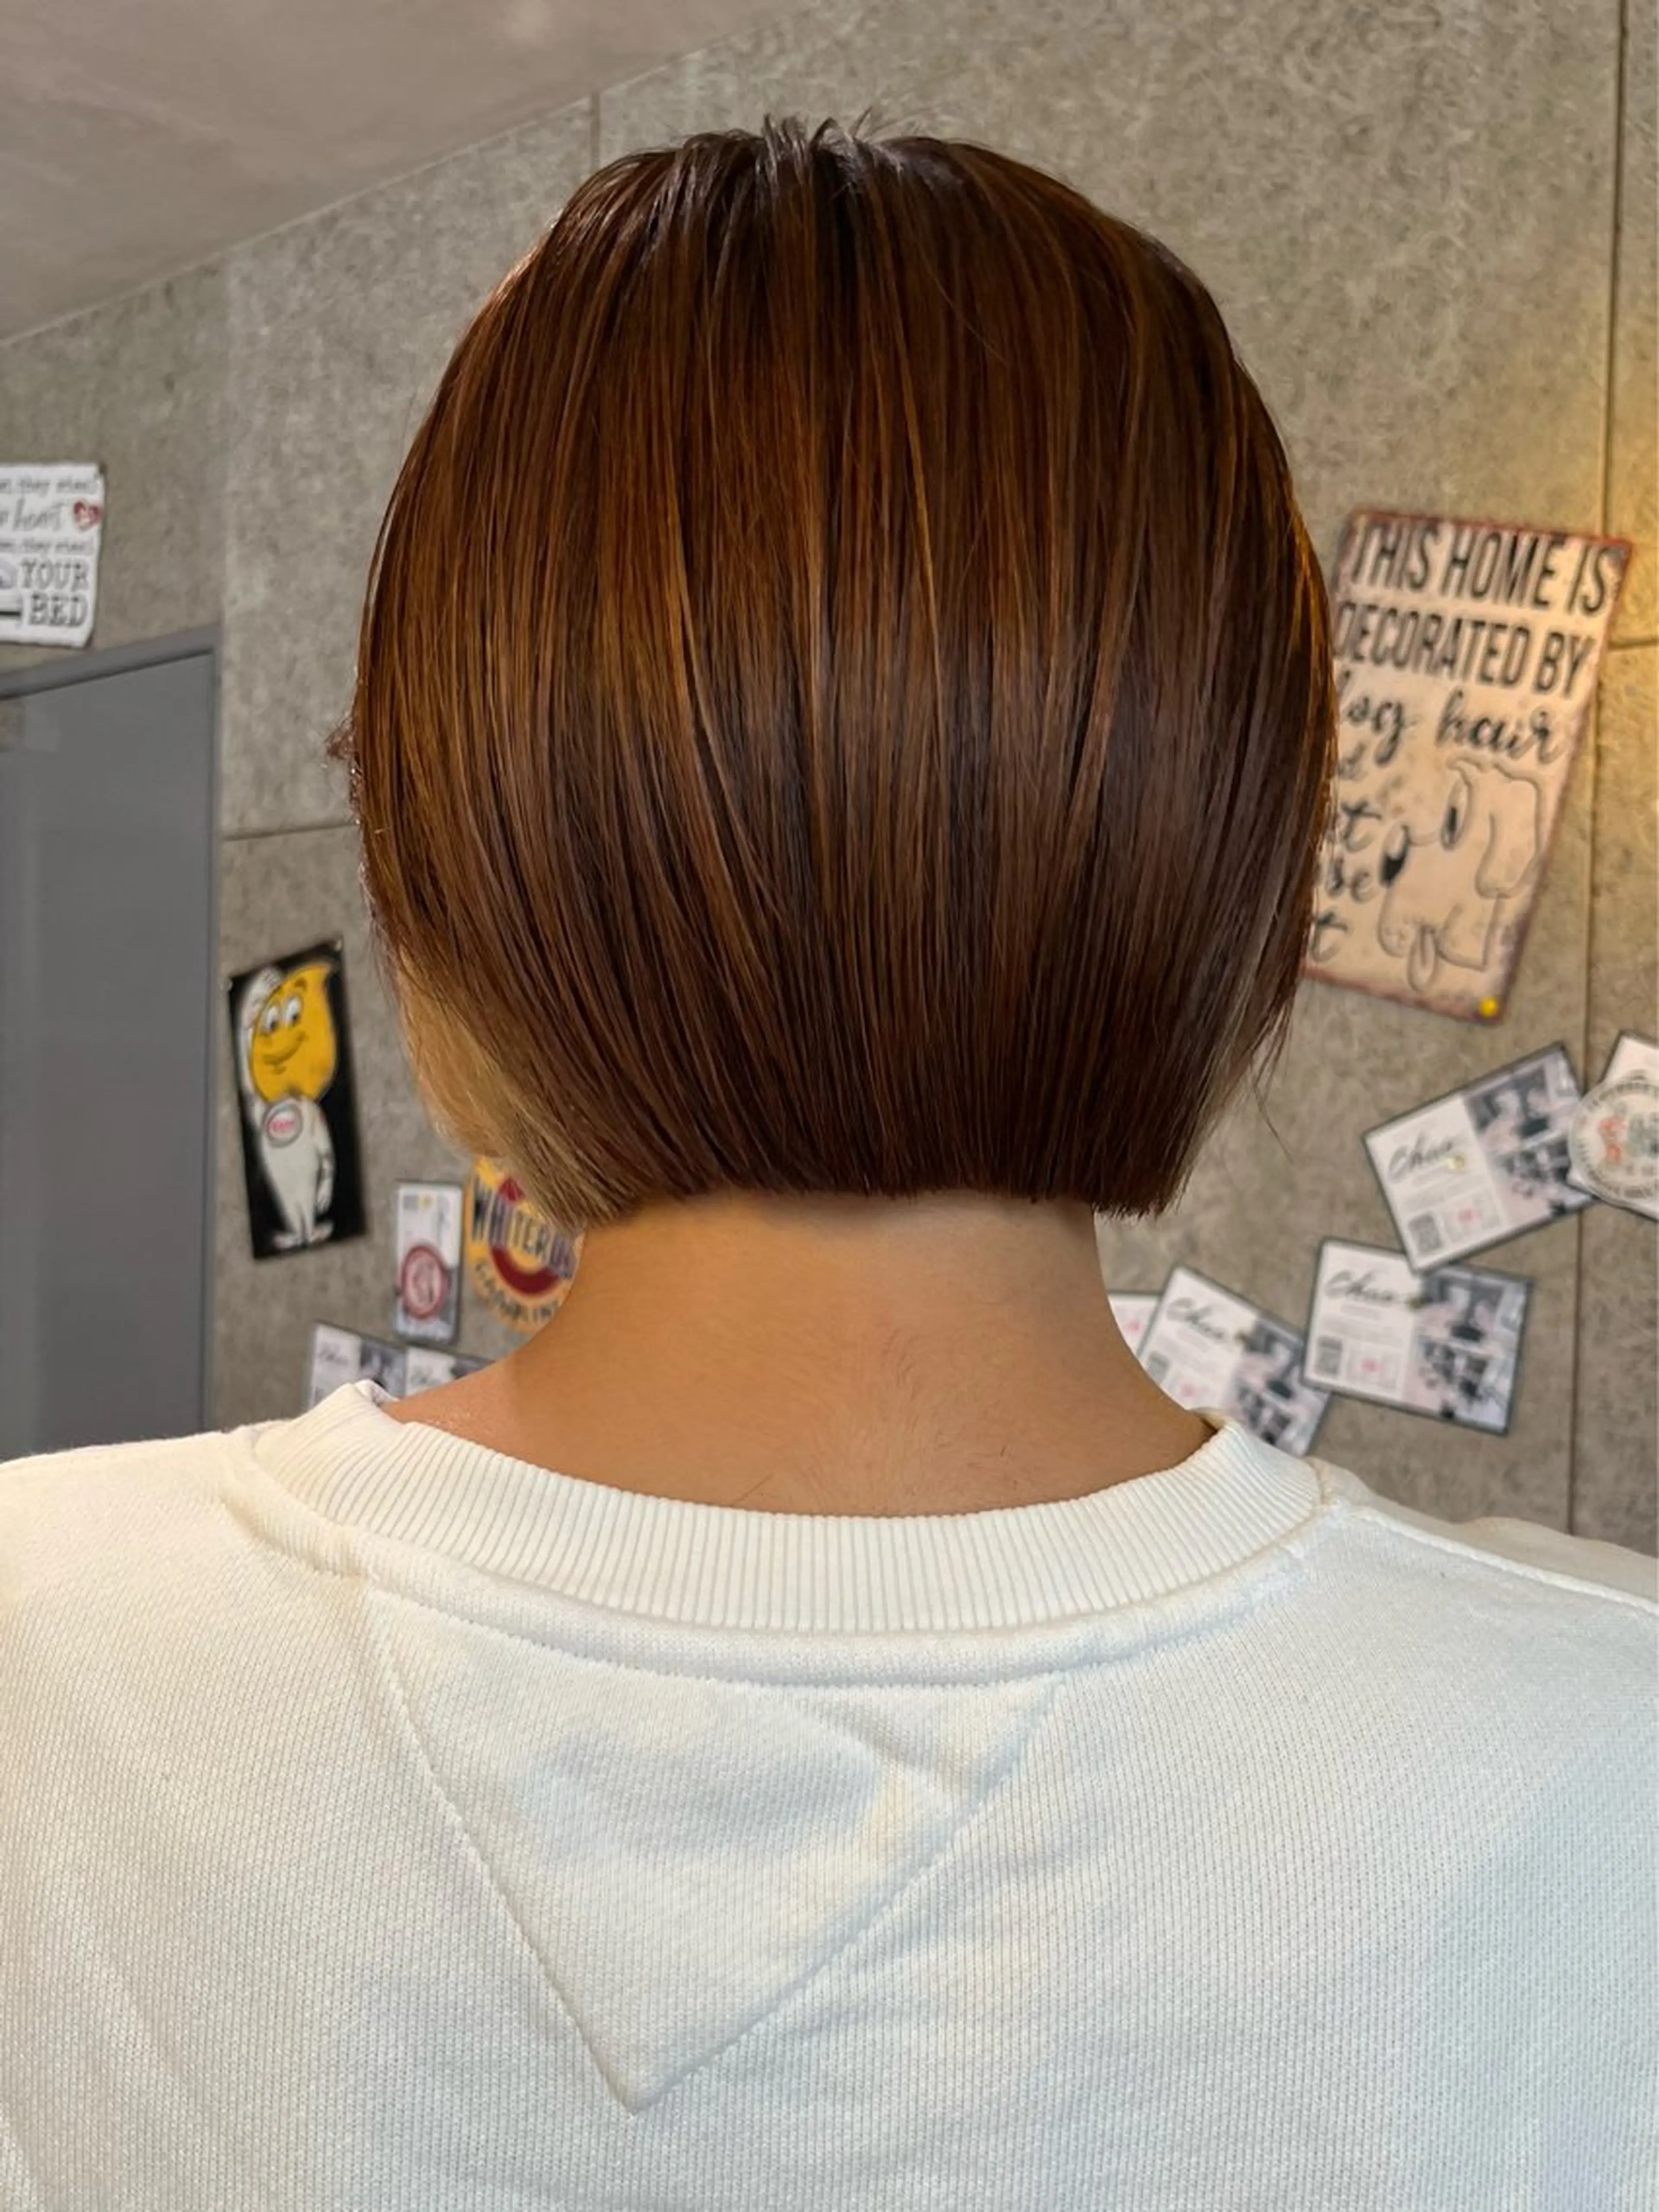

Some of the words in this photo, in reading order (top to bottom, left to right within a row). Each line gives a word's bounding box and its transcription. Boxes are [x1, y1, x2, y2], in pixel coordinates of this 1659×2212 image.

[21, 558, 89, 591] YOUR
[1351, 518, 1439, 589] THIS
[1442, 524, 1565, 607] HOME
[1567, 543, 1614, 618] IS
[28, 591, 88, 626] BED
[1333, 601, 1532, 687] DECORATED
[1535, 631, 1595, 699] BY
[1436, 687, 1564, 765] hair
